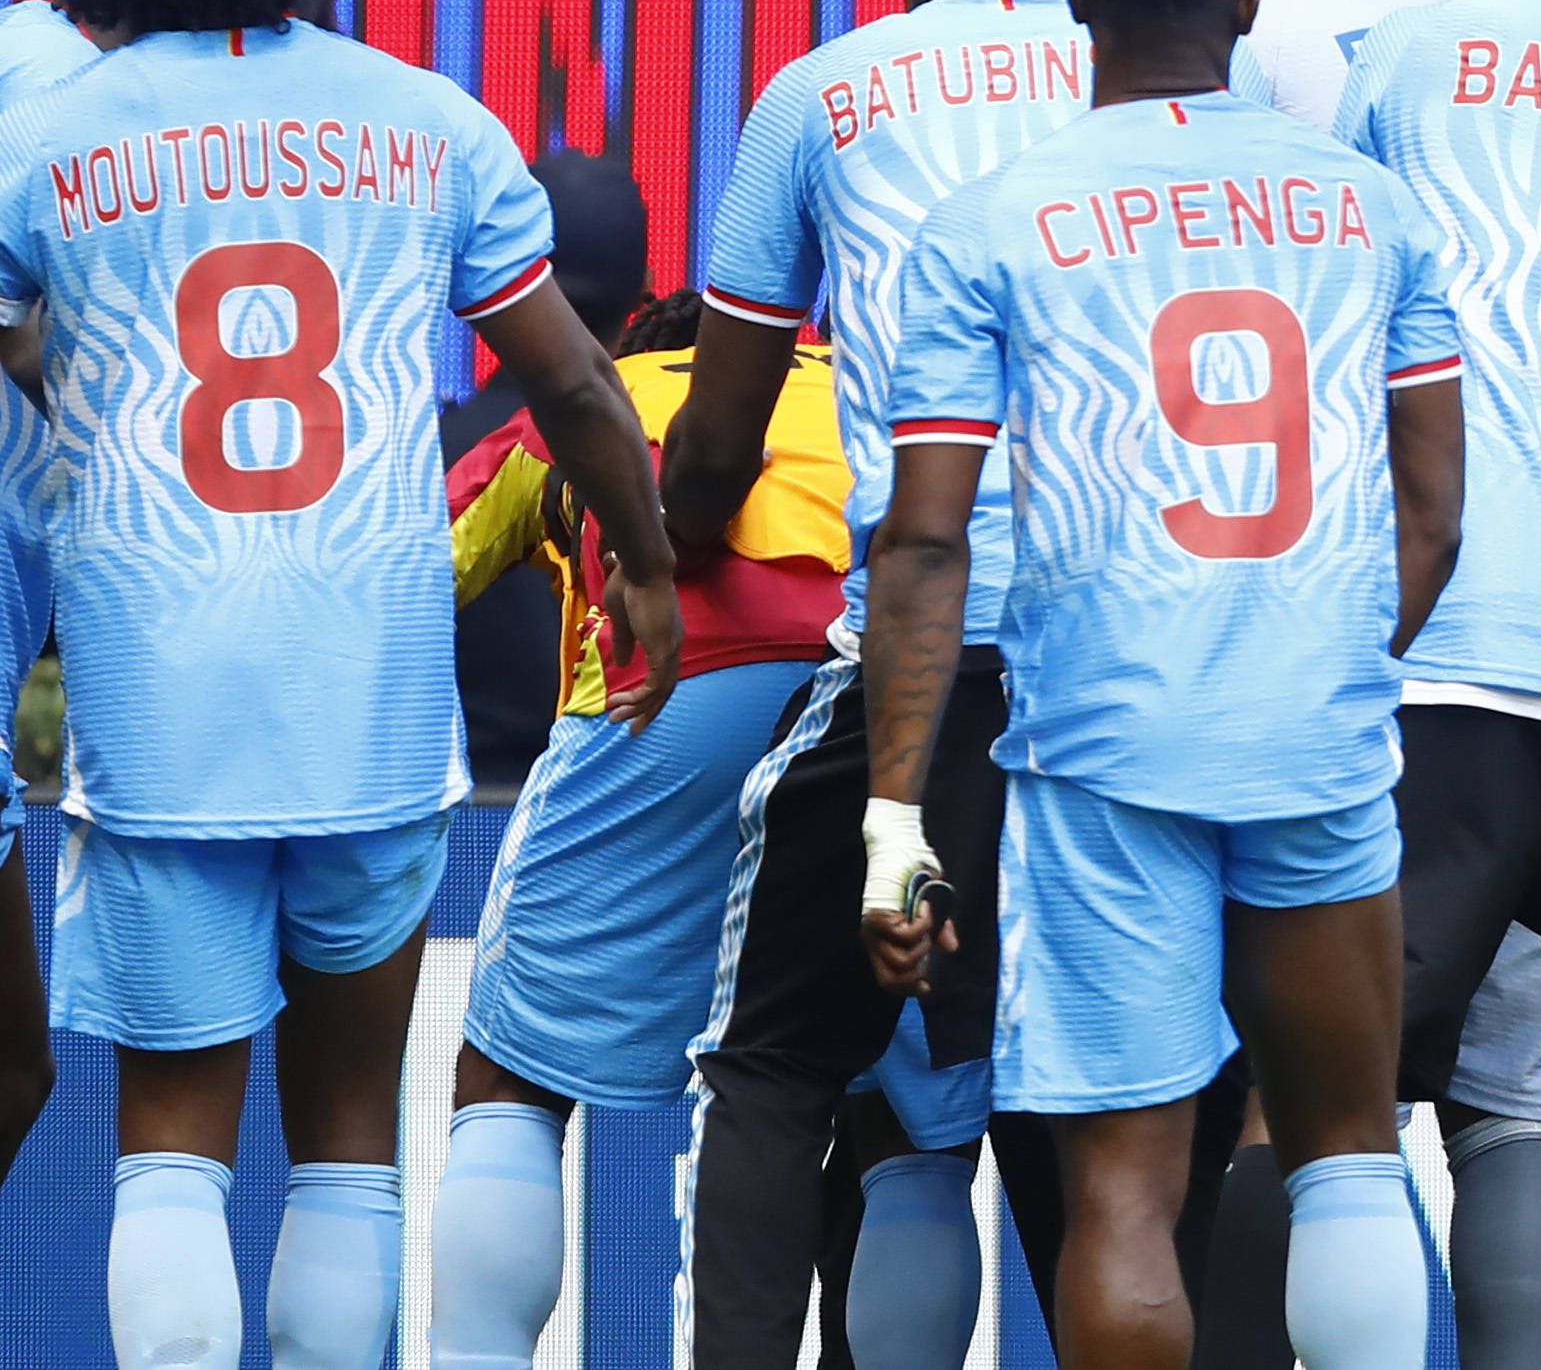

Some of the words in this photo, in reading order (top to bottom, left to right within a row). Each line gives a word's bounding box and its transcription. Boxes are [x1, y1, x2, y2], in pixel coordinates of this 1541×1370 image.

[820, 40, 1095, 152] BATUBIN
[49, 118, 449, 239] MOUTOUSSAMY
[1035, 176, 1373, 268] CIPENGA
[175, 240, 345, 514] 8
[1149, 288, 1316, 558] 9
